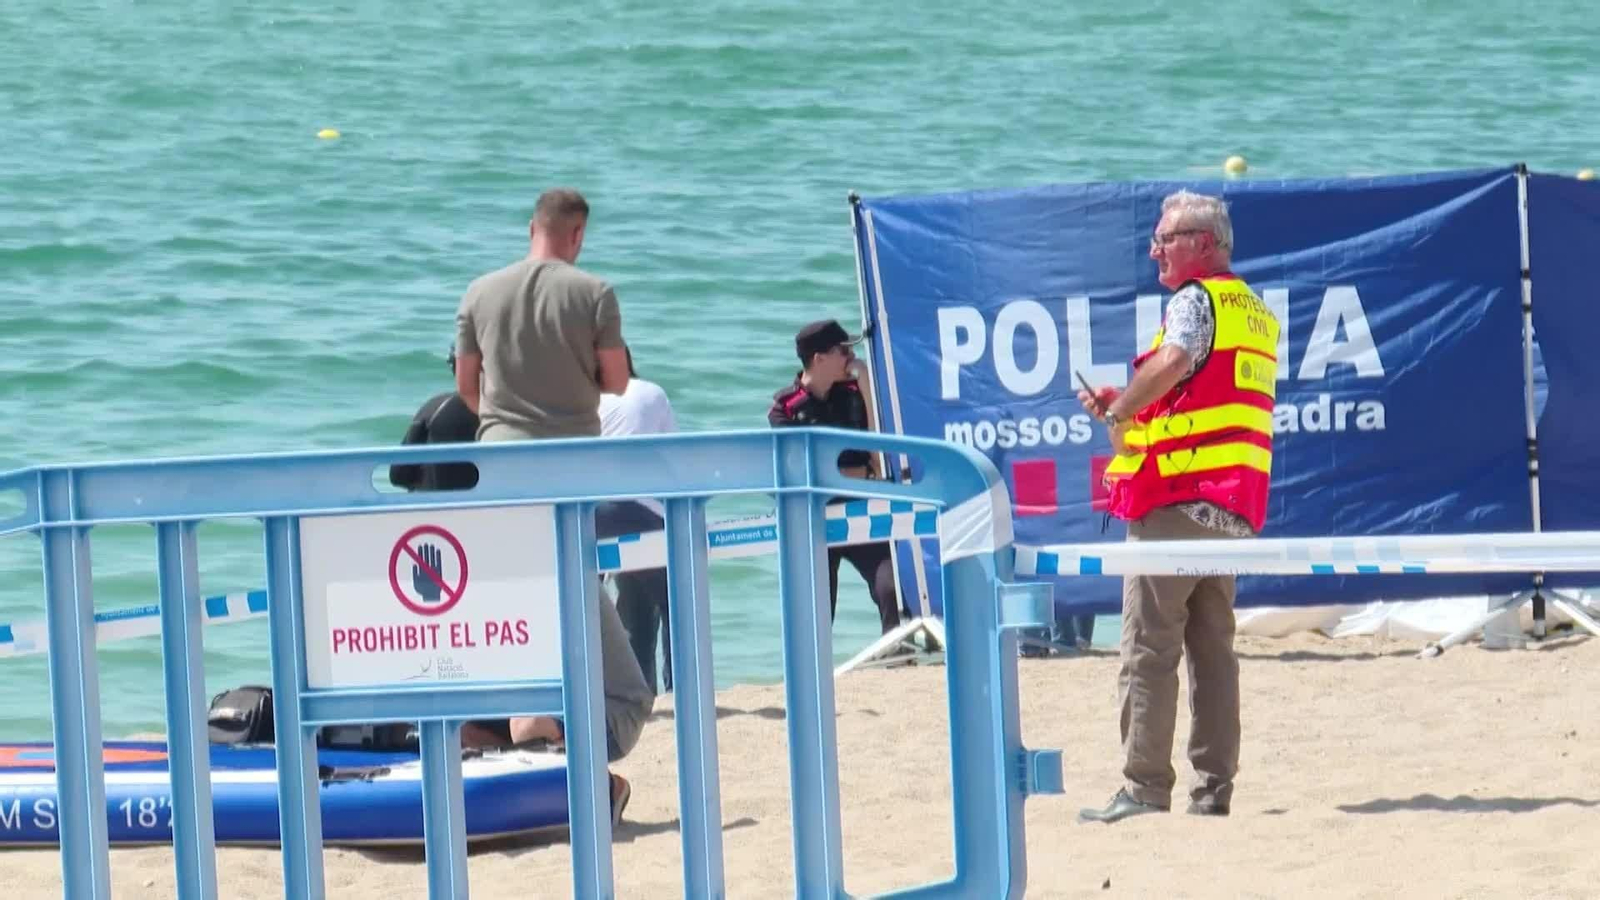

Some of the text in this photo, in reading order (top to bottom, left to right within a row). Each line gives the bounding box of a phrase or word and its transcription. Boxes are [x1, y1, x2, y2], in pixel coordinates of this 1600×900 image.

[937, 285, 1385, 399] POLIIA
[1247, 314, 1270, 337] CIVIL
[944, 410, 1093, 449] mossos
[714, 529, 774, 544] Ajuntament de
[332, 619, 530, 654] PROHIBIT EL PAS
